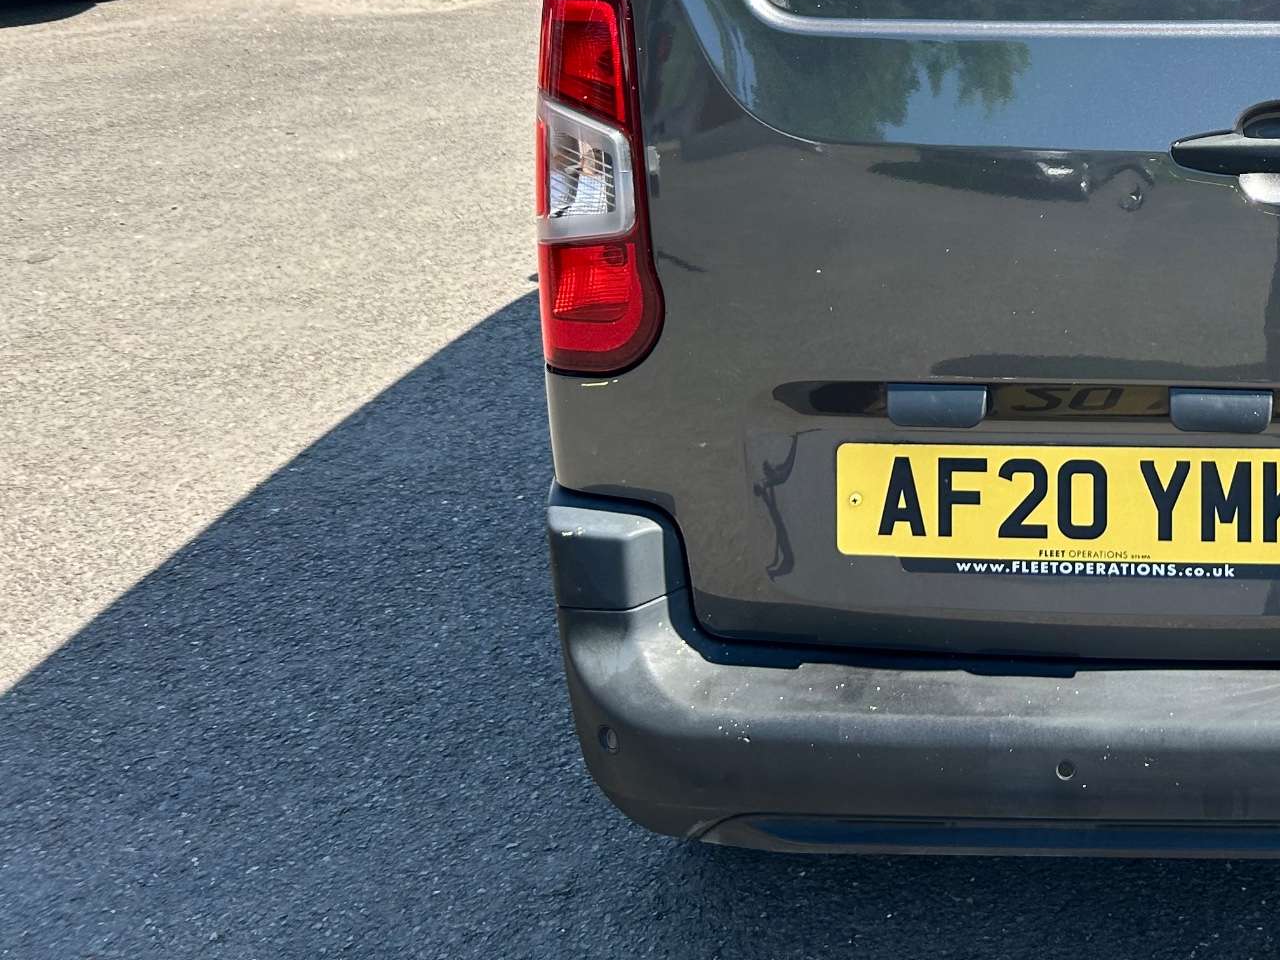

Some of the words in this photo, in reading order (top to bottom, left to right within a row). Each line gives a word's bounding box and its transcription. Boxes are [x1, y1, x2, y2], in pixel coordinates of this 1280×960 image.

[877, 455, 1108, 540] AF20
[1038, 549, 1066, 558] FLEET
[1068, 549, 1129, 560] OPERATIONS
[955, 560, 1236, 578] www.FLEETOPERATIONS.co.uk
